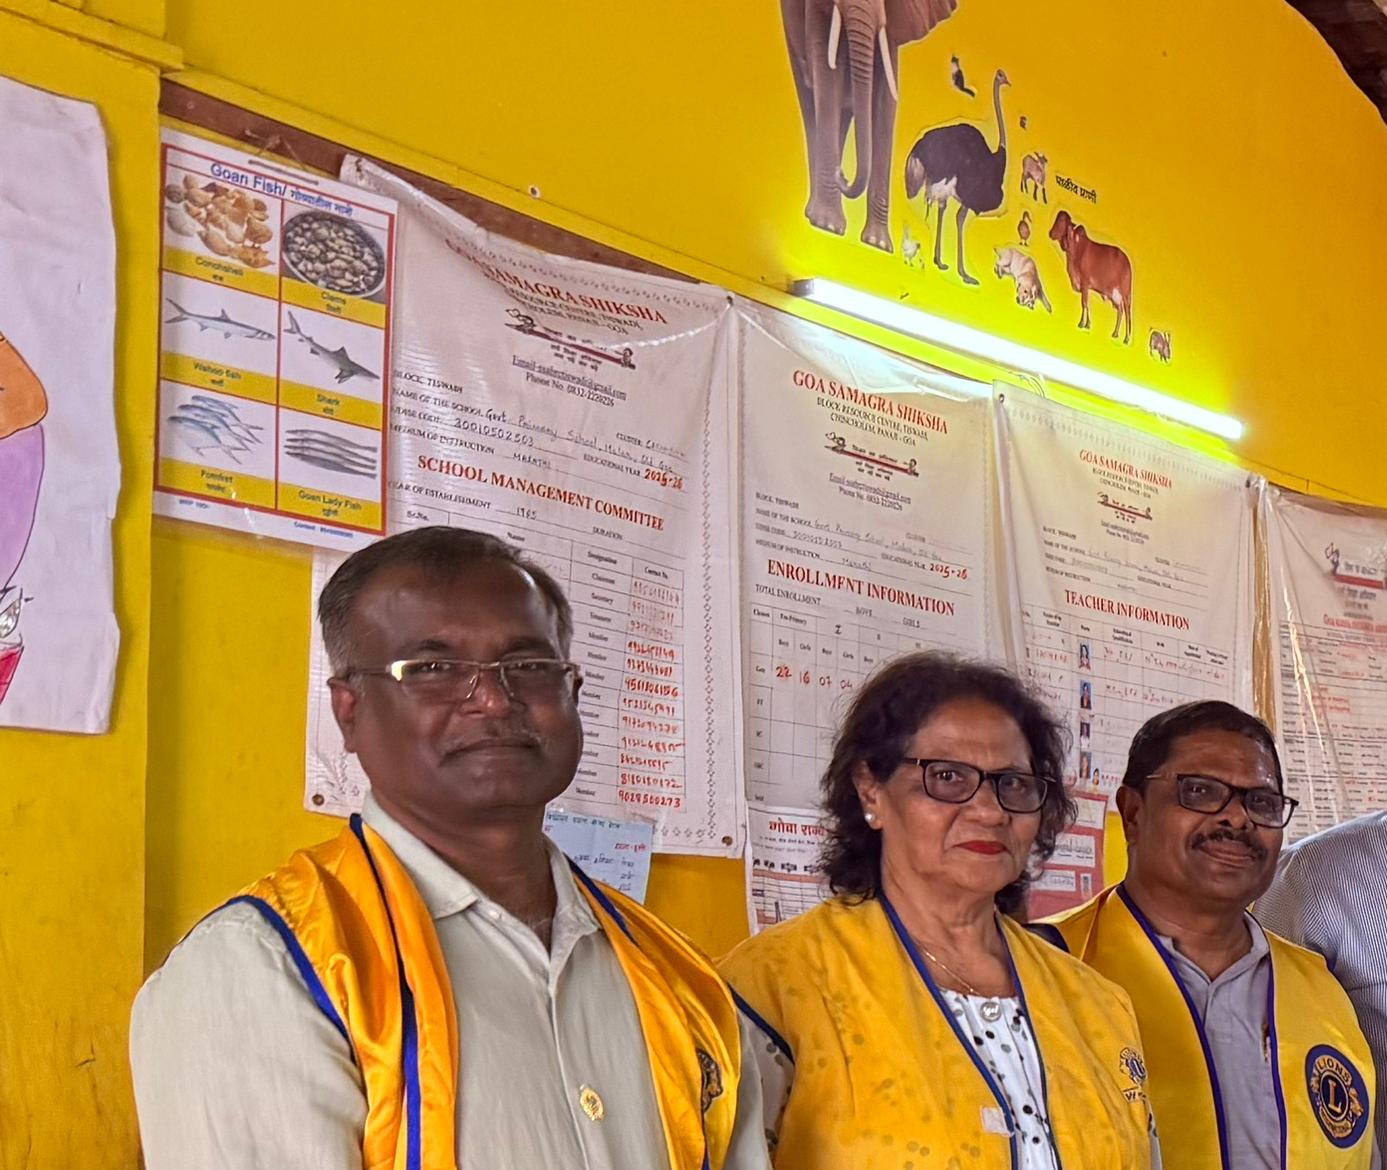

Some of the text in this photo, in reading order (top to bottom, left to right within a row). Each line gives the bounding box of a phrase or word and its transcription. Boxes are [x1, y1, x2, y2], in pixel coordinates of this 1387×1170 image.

[210, 164, 287, 196] Goan Fish/
[581, 294, 667, 324] SHIKSHA
[793, 369, 948, 434] GOA SAMAGRA SHIKSHA
[1080, 449, 1099, 465] GOA
[1100, 457, 1138, 479] SAMAGRA
[1140, 469, 1172, 489] SHIKSHA
[418, 455, 664, 531] SCHOOL MANAGEMENT COMMITTEE
[756, 584, 776, 596] TOTAL
[768, 559, 954, 616] ENROLLMENT INFORMATION
[1065, 590, 1190, 630] TEACHER INFORMATION
[1318, 1057, 1351, 1083] LIONS
[1328, 1080, 1342, 1114] L
